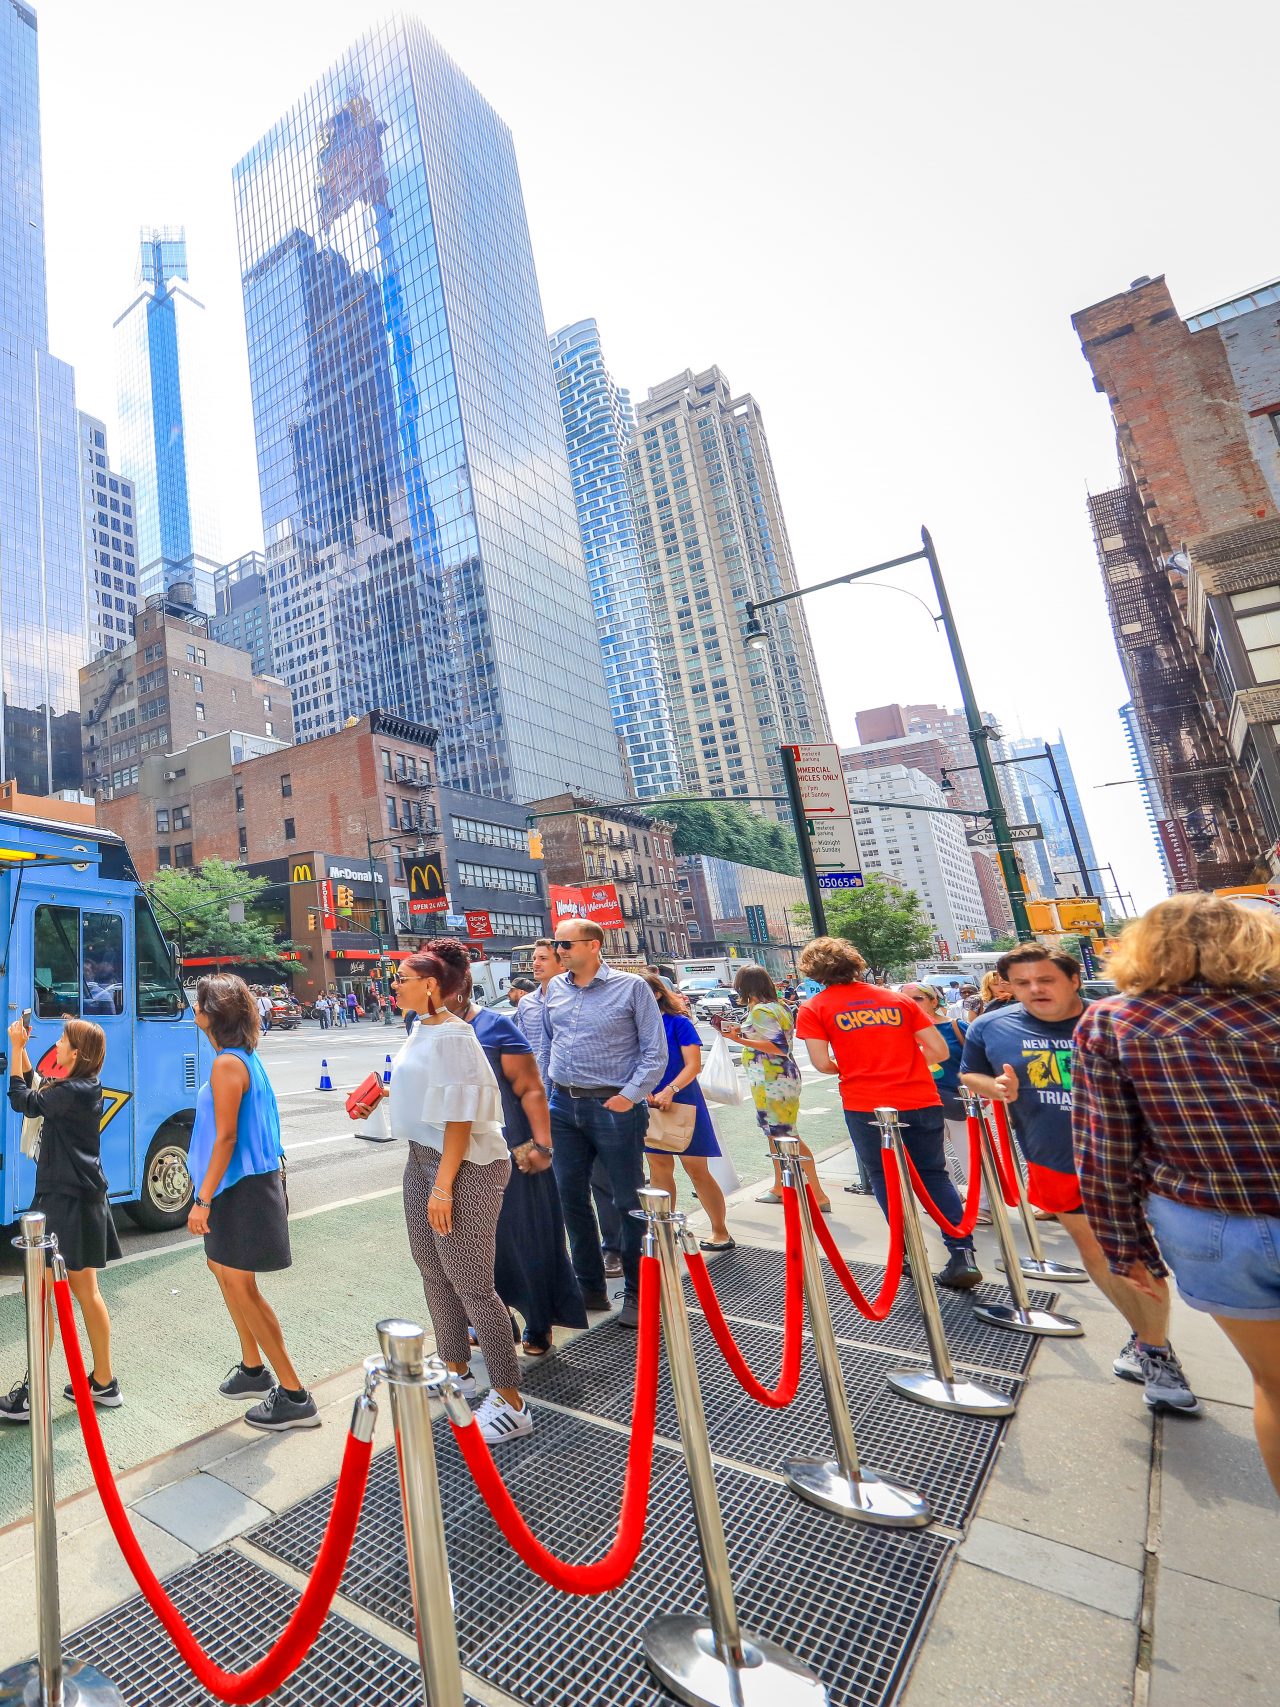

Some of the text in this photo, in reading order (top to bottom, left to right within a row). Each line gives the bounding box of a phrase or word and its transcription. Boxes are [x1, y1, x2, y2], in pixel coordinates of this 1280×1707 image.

[797, 766, 831, 774] MMERCIAL
[798, 773, 839, 782] HICLES ONLY
[818, 878, 850, 888] 05065
[556, 899, 578, 917] Wendy's
[587, 898, 618, 912] Wendy's
[1022, 1039, 1074, 1049] NEW YO
[1037, 1090, 1072, 1105] TRIA
